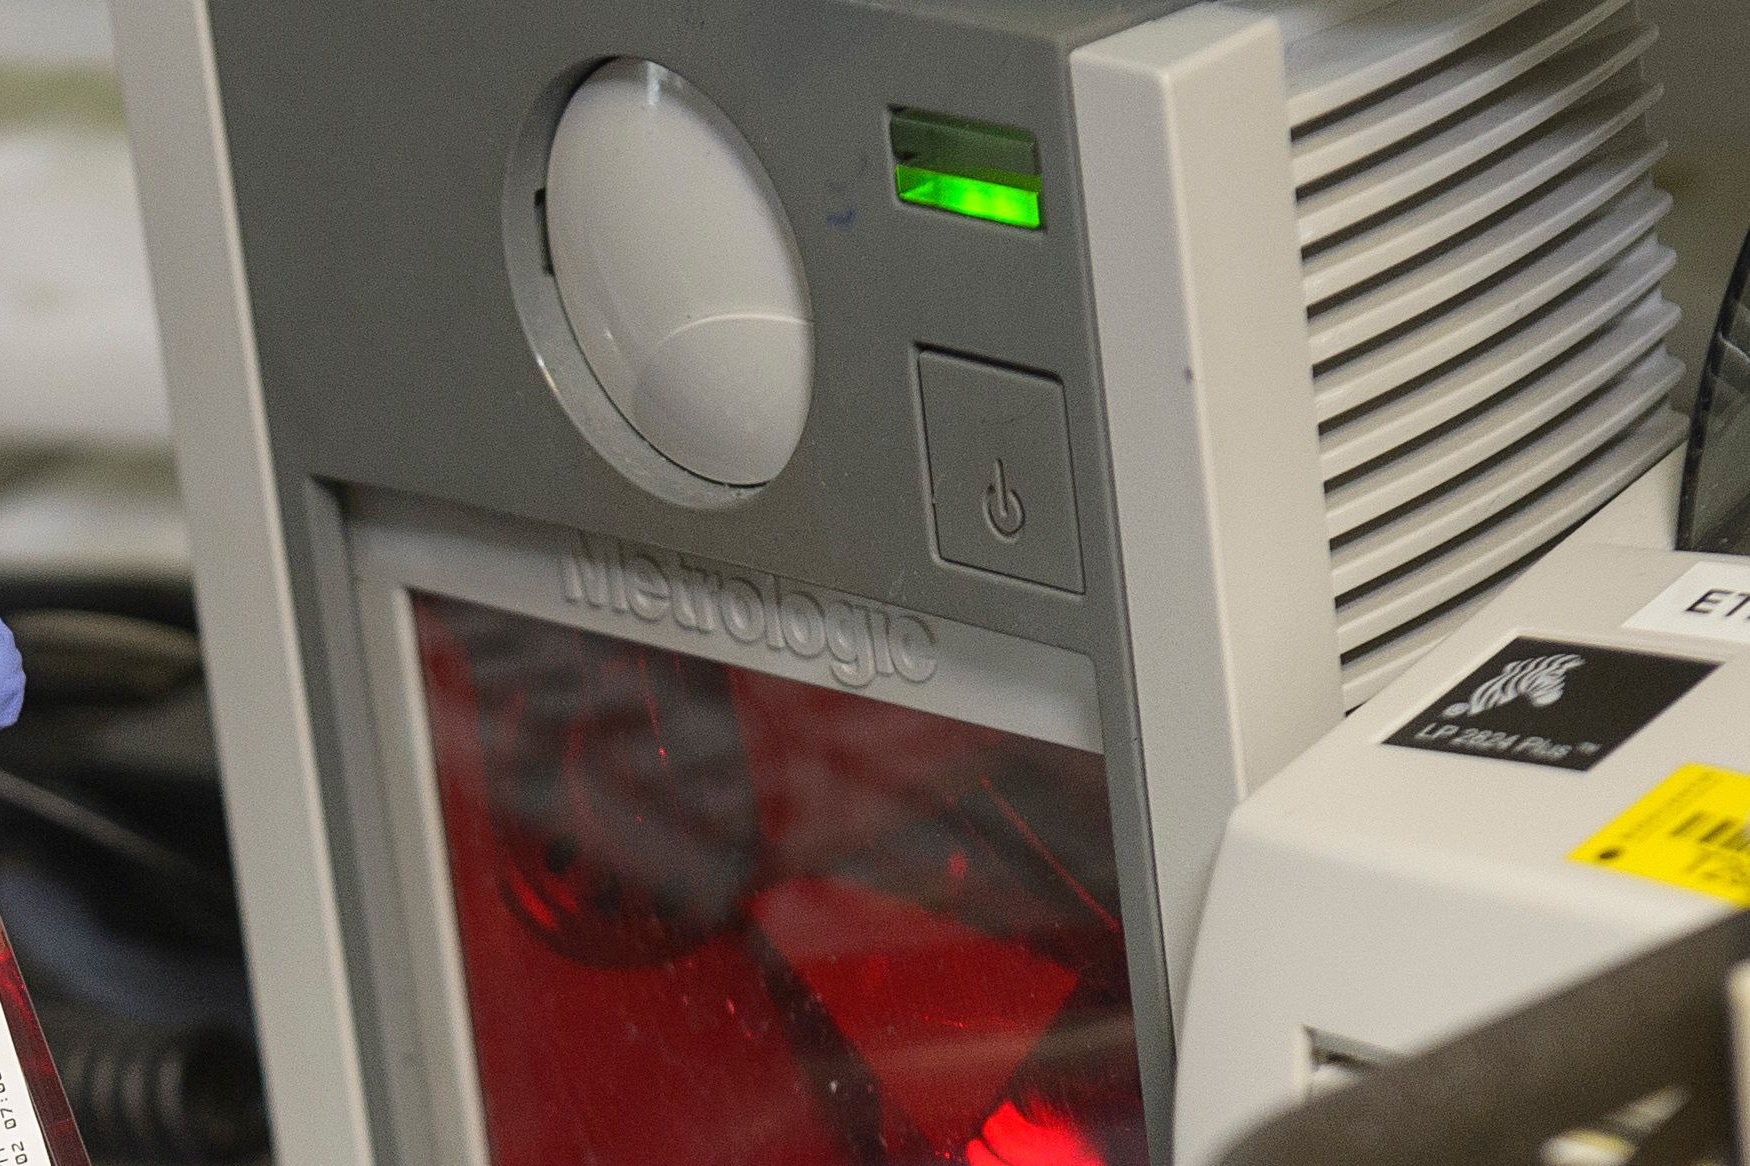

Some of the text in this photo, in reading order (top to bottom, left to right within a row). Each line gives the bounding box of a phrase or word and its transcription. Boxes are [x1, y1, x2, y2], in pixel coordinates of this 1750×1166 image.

[560, 532, 938, 688] Metrologic
[1684, 588, 1750, 621] ET
[1414, 722, 1460, 741] LP
